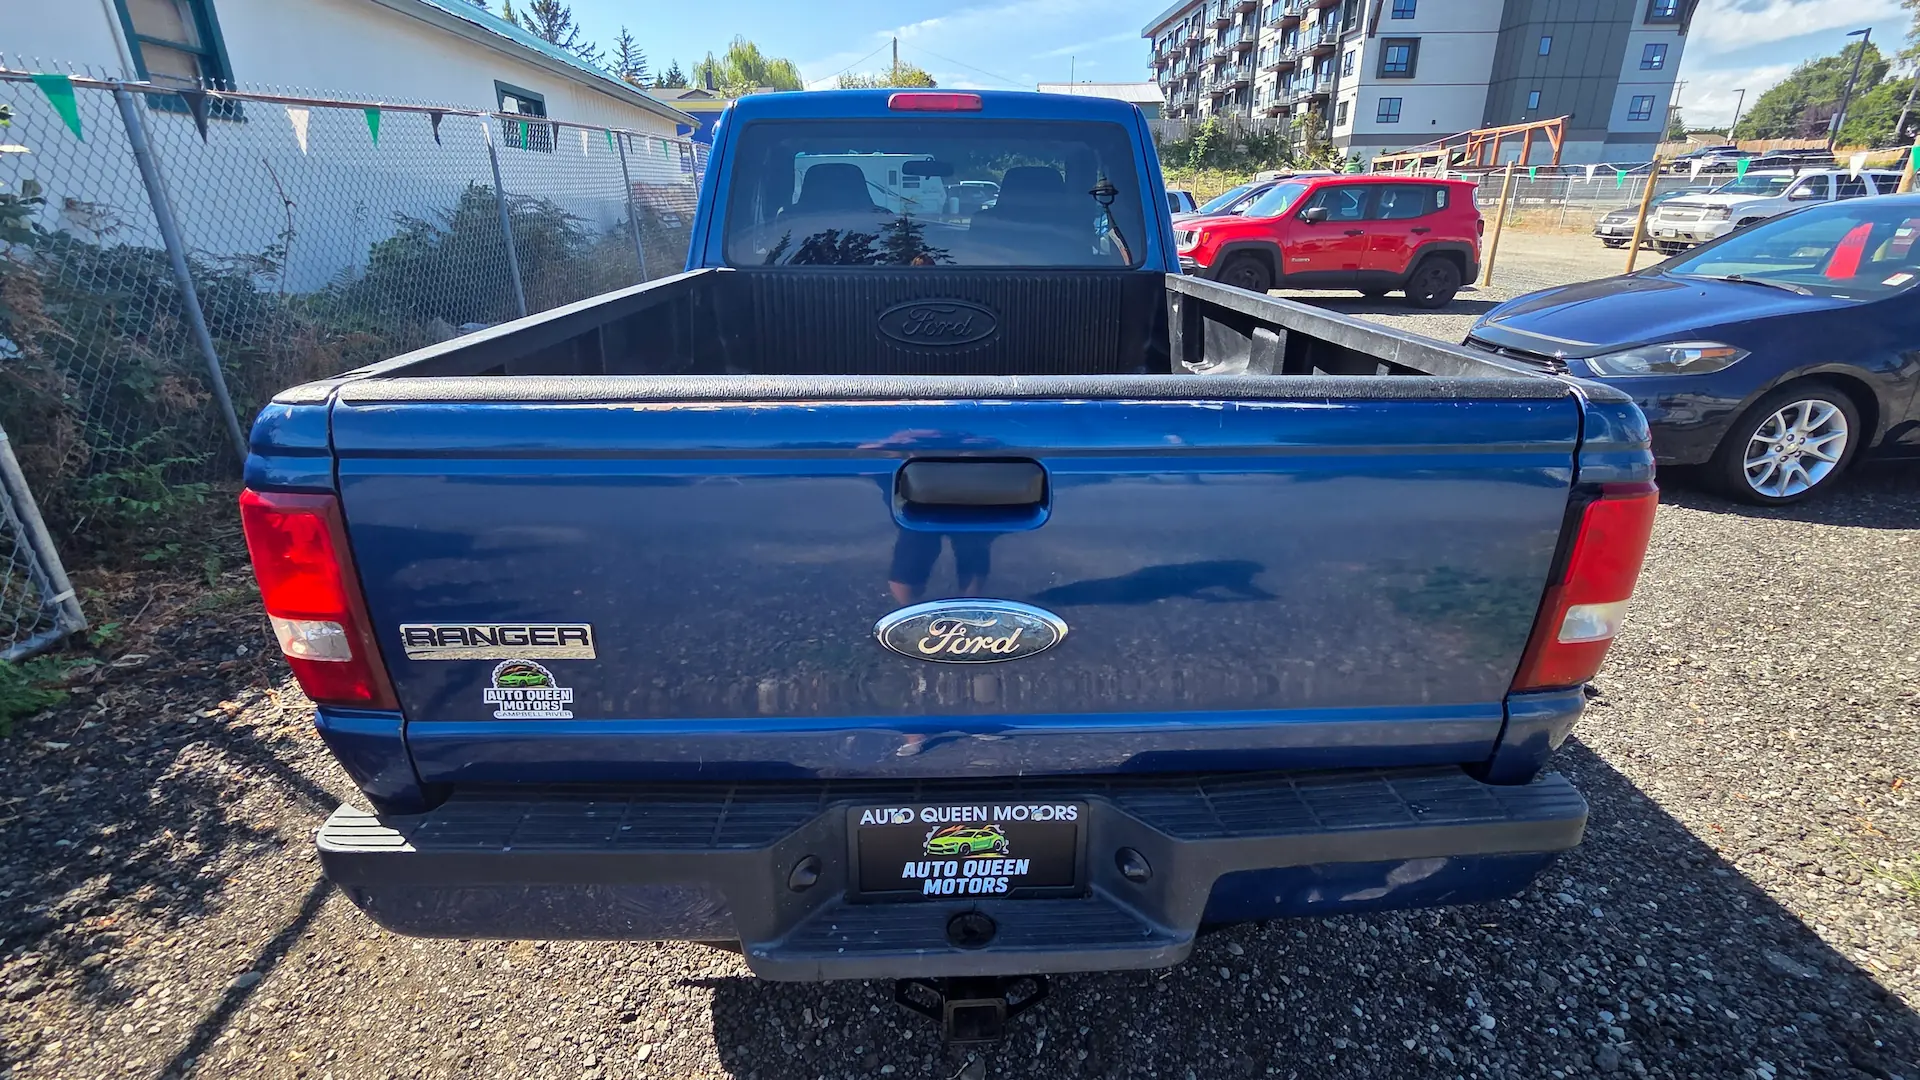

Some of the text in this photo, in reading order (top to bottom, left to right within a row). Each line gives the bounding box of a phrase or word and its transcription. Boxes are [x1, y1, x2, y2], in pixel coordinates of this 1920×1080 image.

[902, 305, 973, 336] Ford
[403, 626, 590, 647] RANGER
[917, 616, 1024, 655] Ford
[487, 690, 570, 701] AUTO QUEEN
[503, 700, 560, 711] MOTORS
[859, 804, 1078, 825] AUTO QUEEN MOTORS
[901, 858, 1031, 879] AUTO QUEEN
[923, 876, 1010, 896] MOTORS
